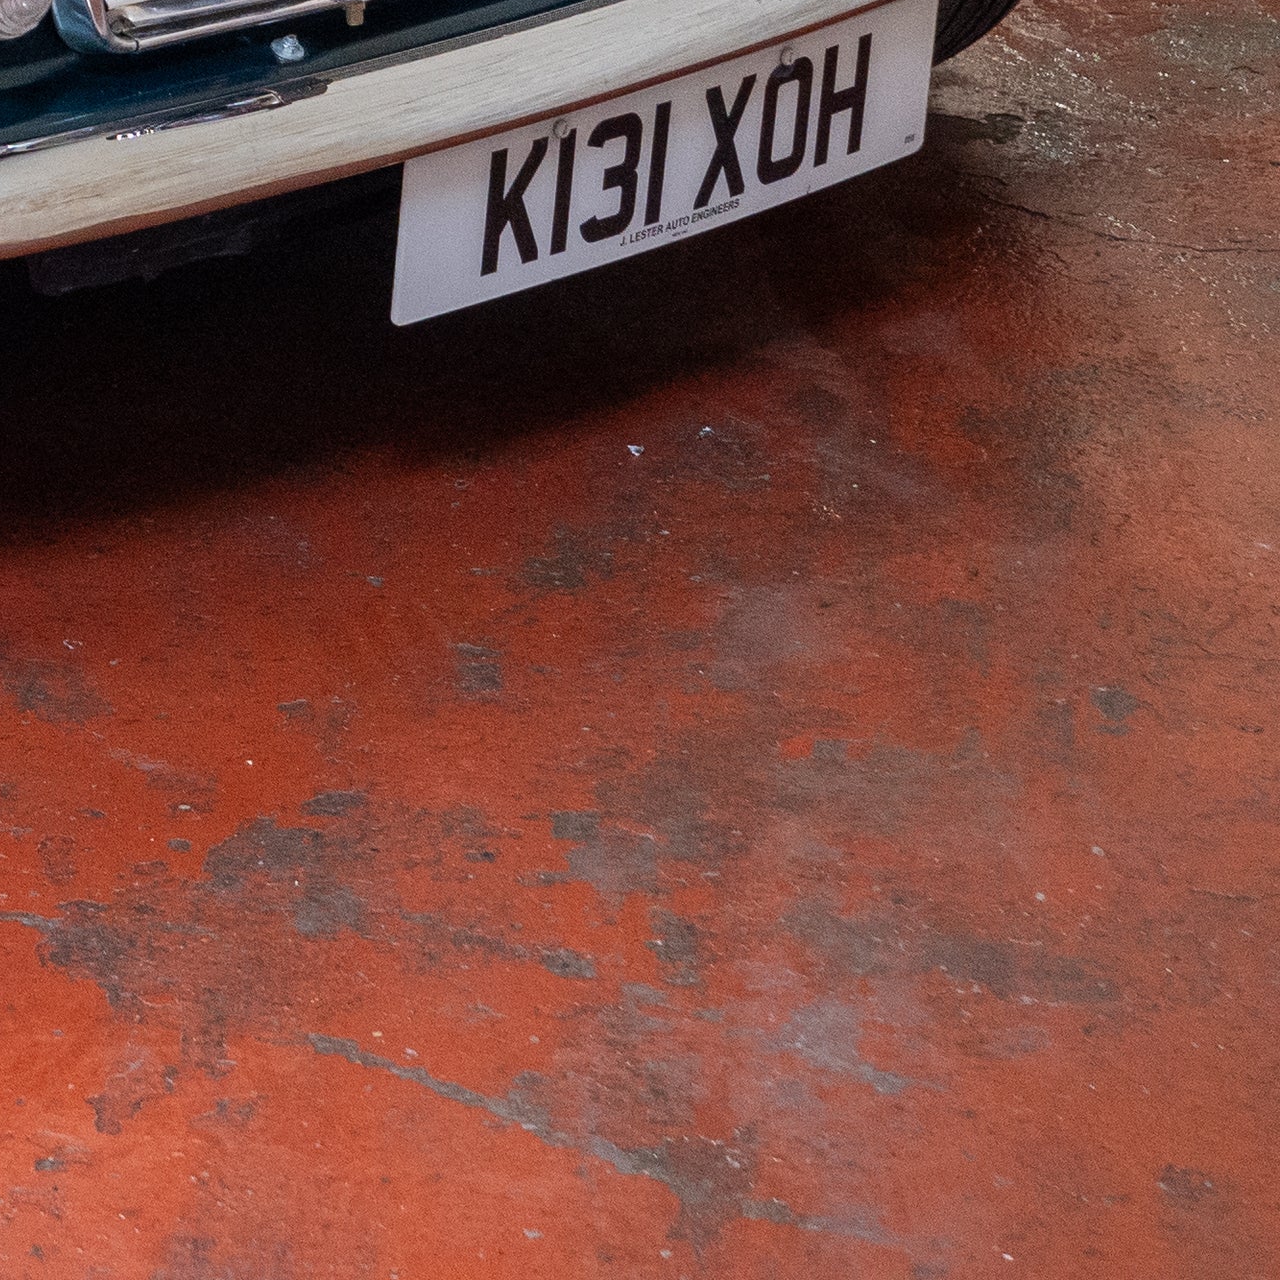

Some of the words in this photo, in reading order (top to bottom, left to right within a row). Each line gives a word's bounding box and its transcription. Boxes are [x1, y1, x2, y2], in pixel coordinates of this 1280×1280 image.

[480, 101, 672, 277] K131
[693, 33, 872, 210] XOH
[630, 225, 664, 243] LESTER
[665, 215, 690, 232] AUTO
[691, 198, 740, 224] ENGINEERS
